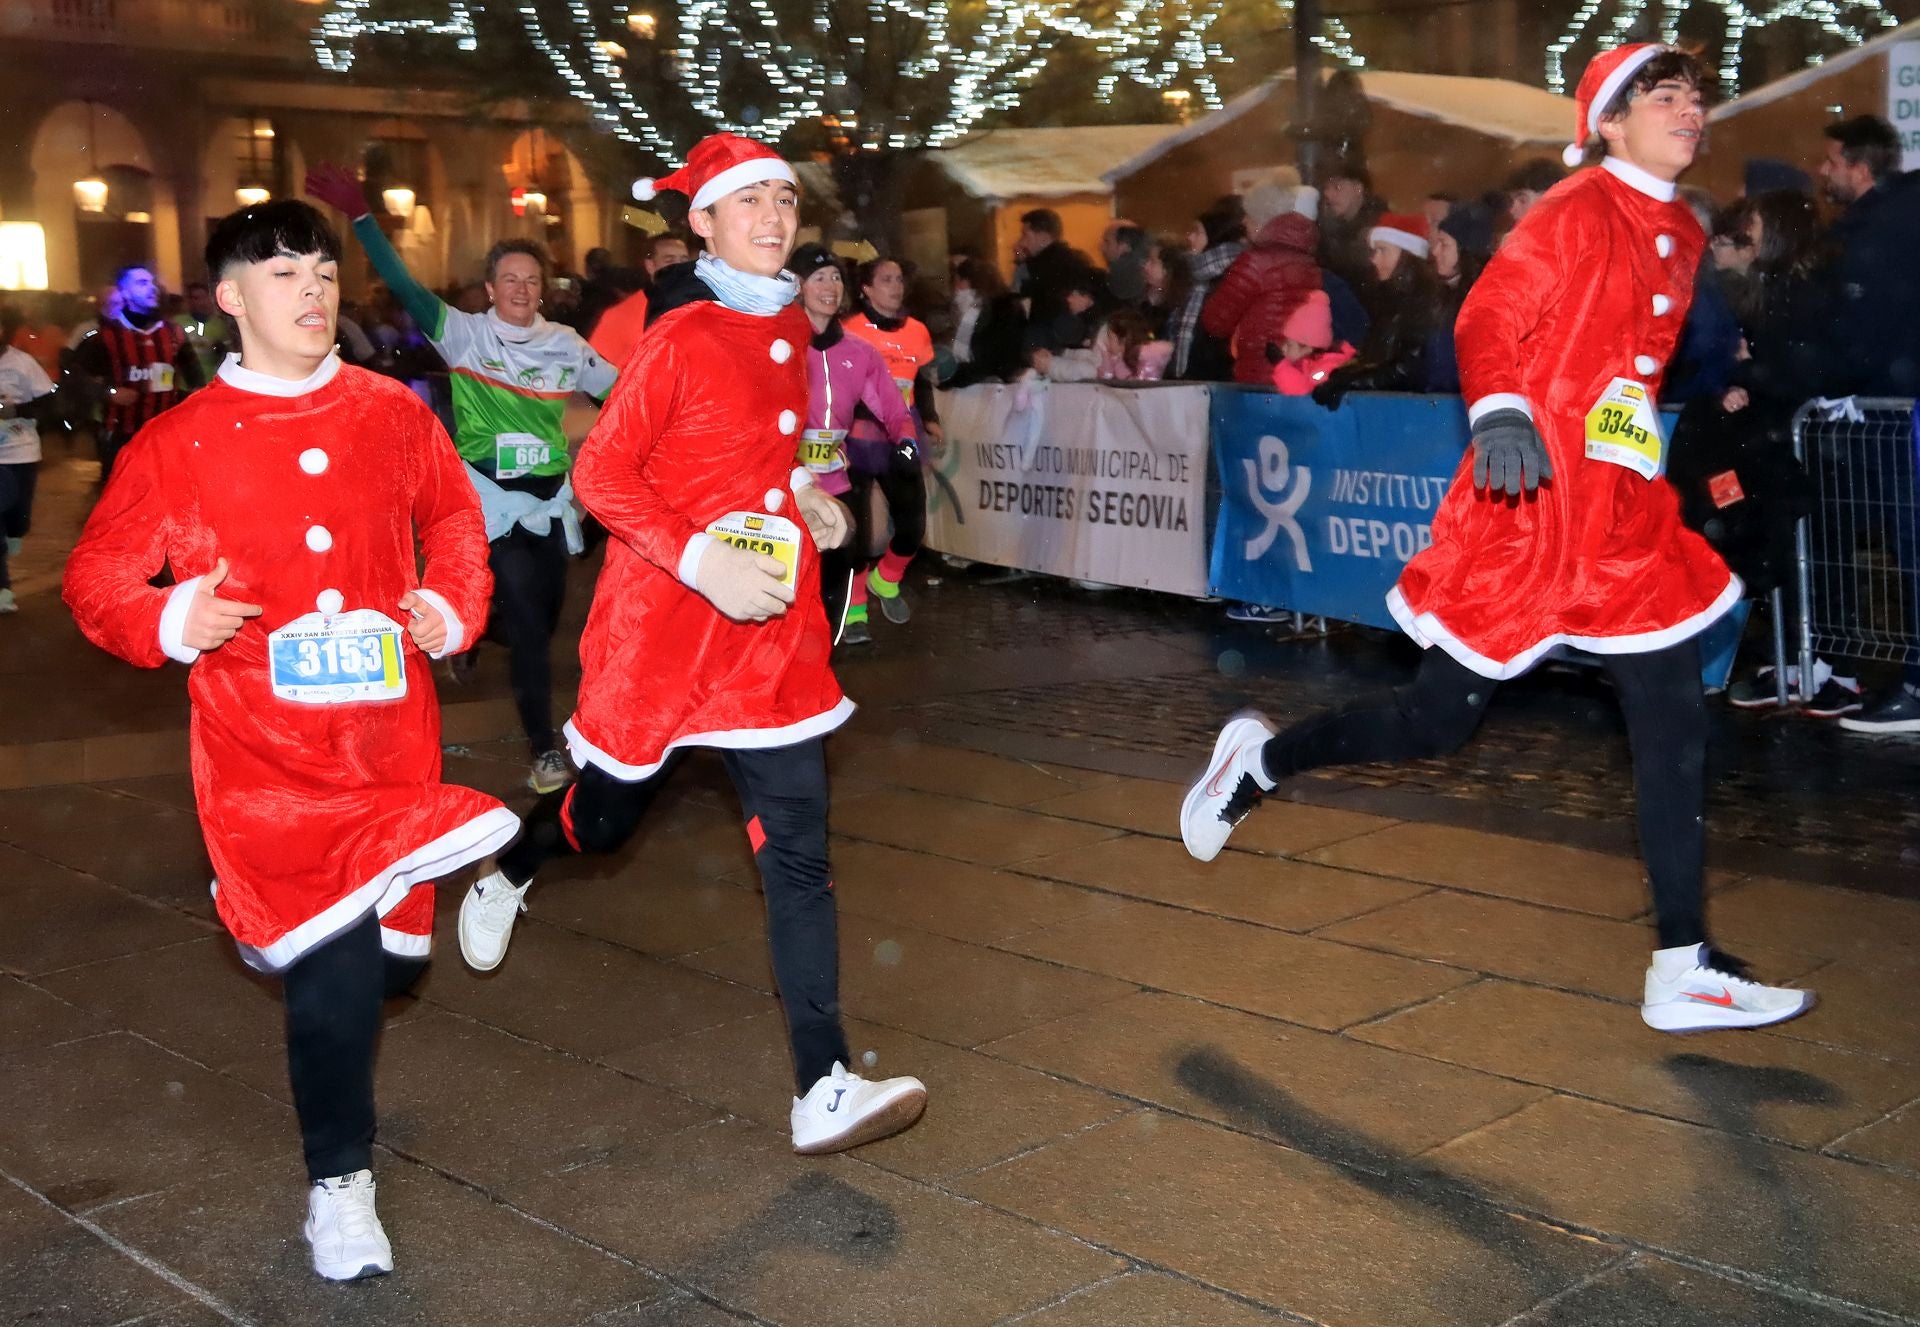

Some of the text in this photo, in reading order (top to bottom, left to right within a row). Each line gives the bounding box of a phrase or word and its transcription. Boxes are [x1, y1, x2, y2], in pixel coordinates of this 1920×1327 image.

[516, 446, 550, 465] 664
[808, 443, 831, 459] 173
[977, 443, 1189, 483] INSTIUTO MUNICIPAL DE
[979, 480, 1188, 532] DEPORTES SEGOVIA
[360, 626, 392, 635] SEGOVIANA
[299, 636, 382, 676] 3153
